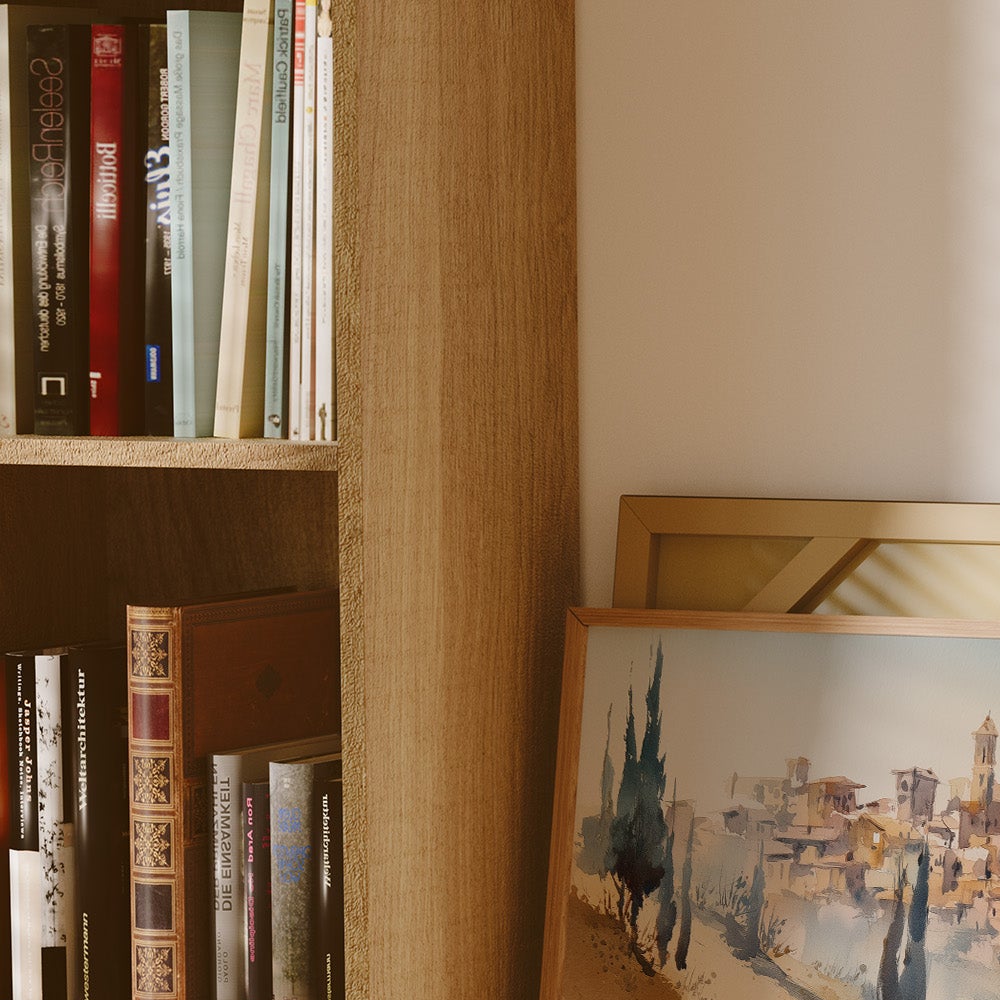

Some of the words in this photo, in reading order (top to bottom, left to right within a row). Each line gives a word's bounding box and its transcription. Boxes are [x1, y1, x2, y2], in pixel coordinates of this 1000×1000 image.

[23, 700, 32, 752] Jasper
[77, 668, 88, 811] Weltarchitektur
[24, 756, 33, 802] Johns
